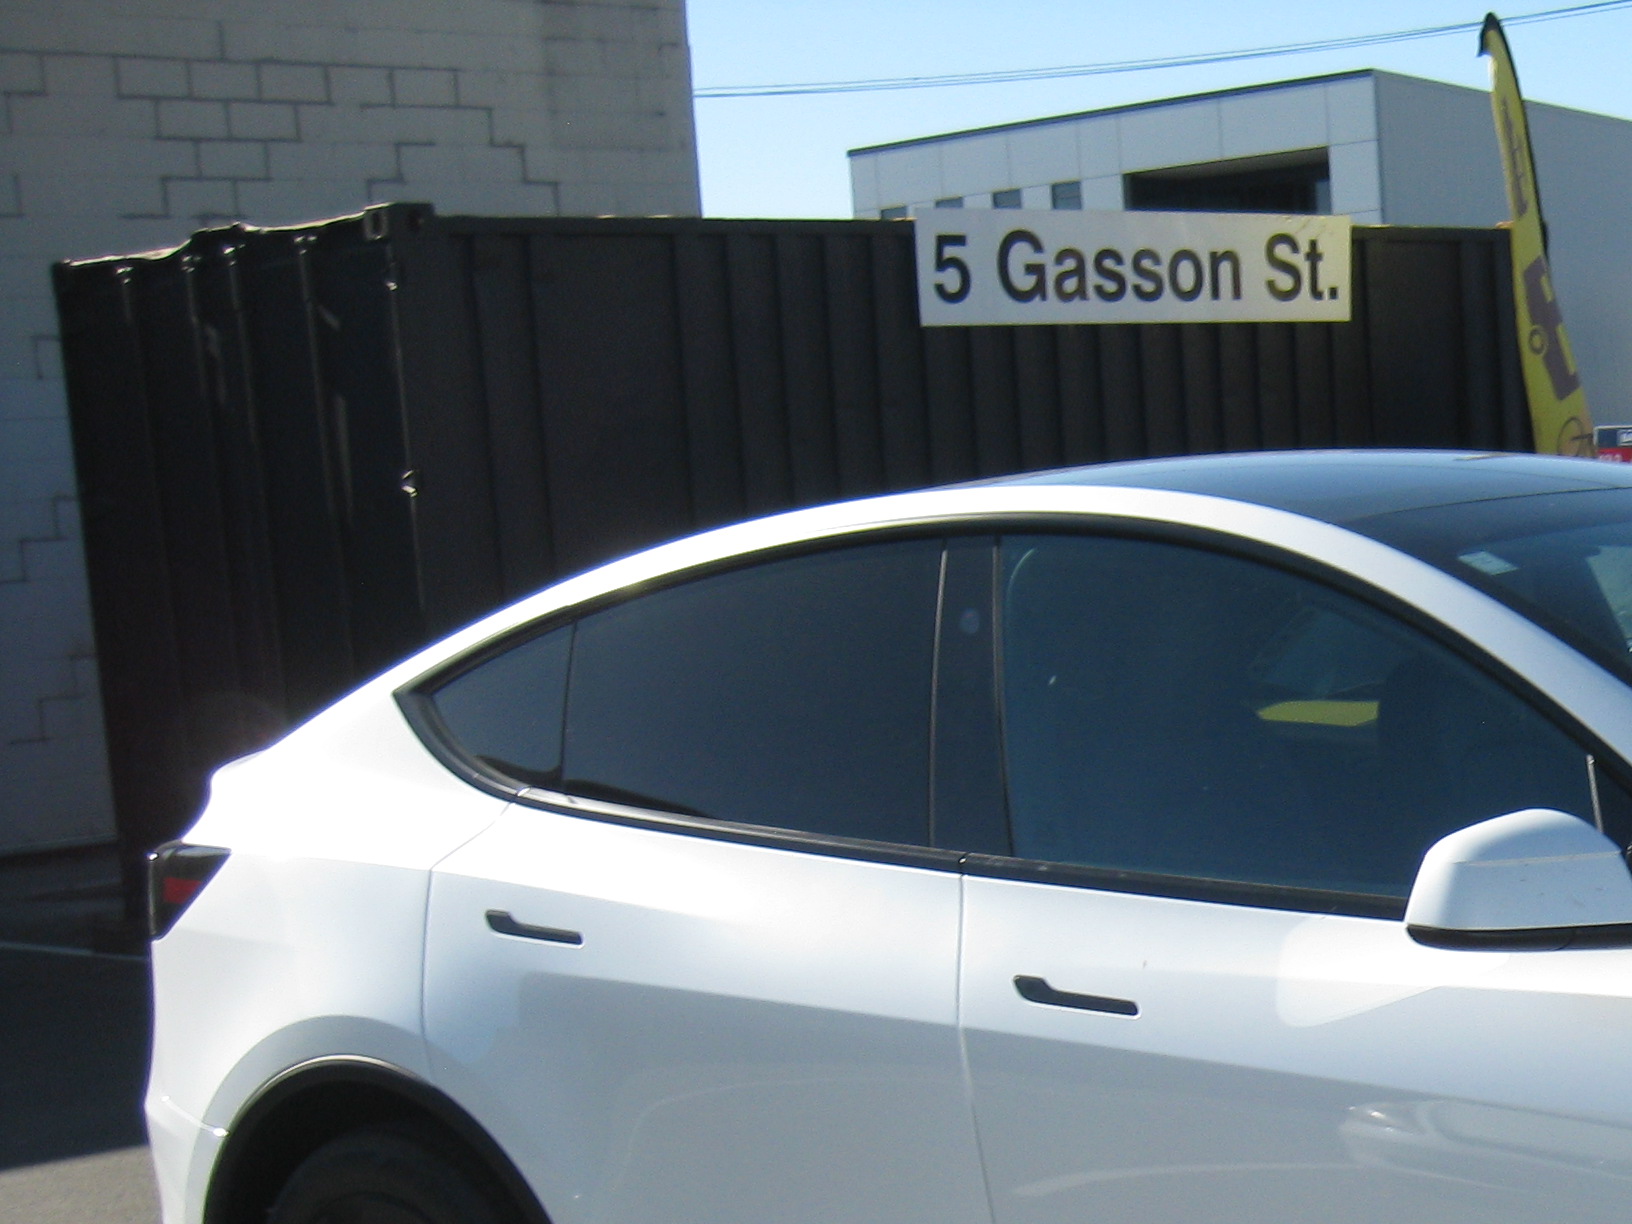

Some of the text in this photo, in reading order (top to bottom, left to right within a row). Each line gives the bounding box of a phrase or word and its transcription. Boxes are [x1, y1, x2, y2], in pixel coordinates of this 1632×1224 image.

[934, 229, 1339, 303] 5 Gasson St.
